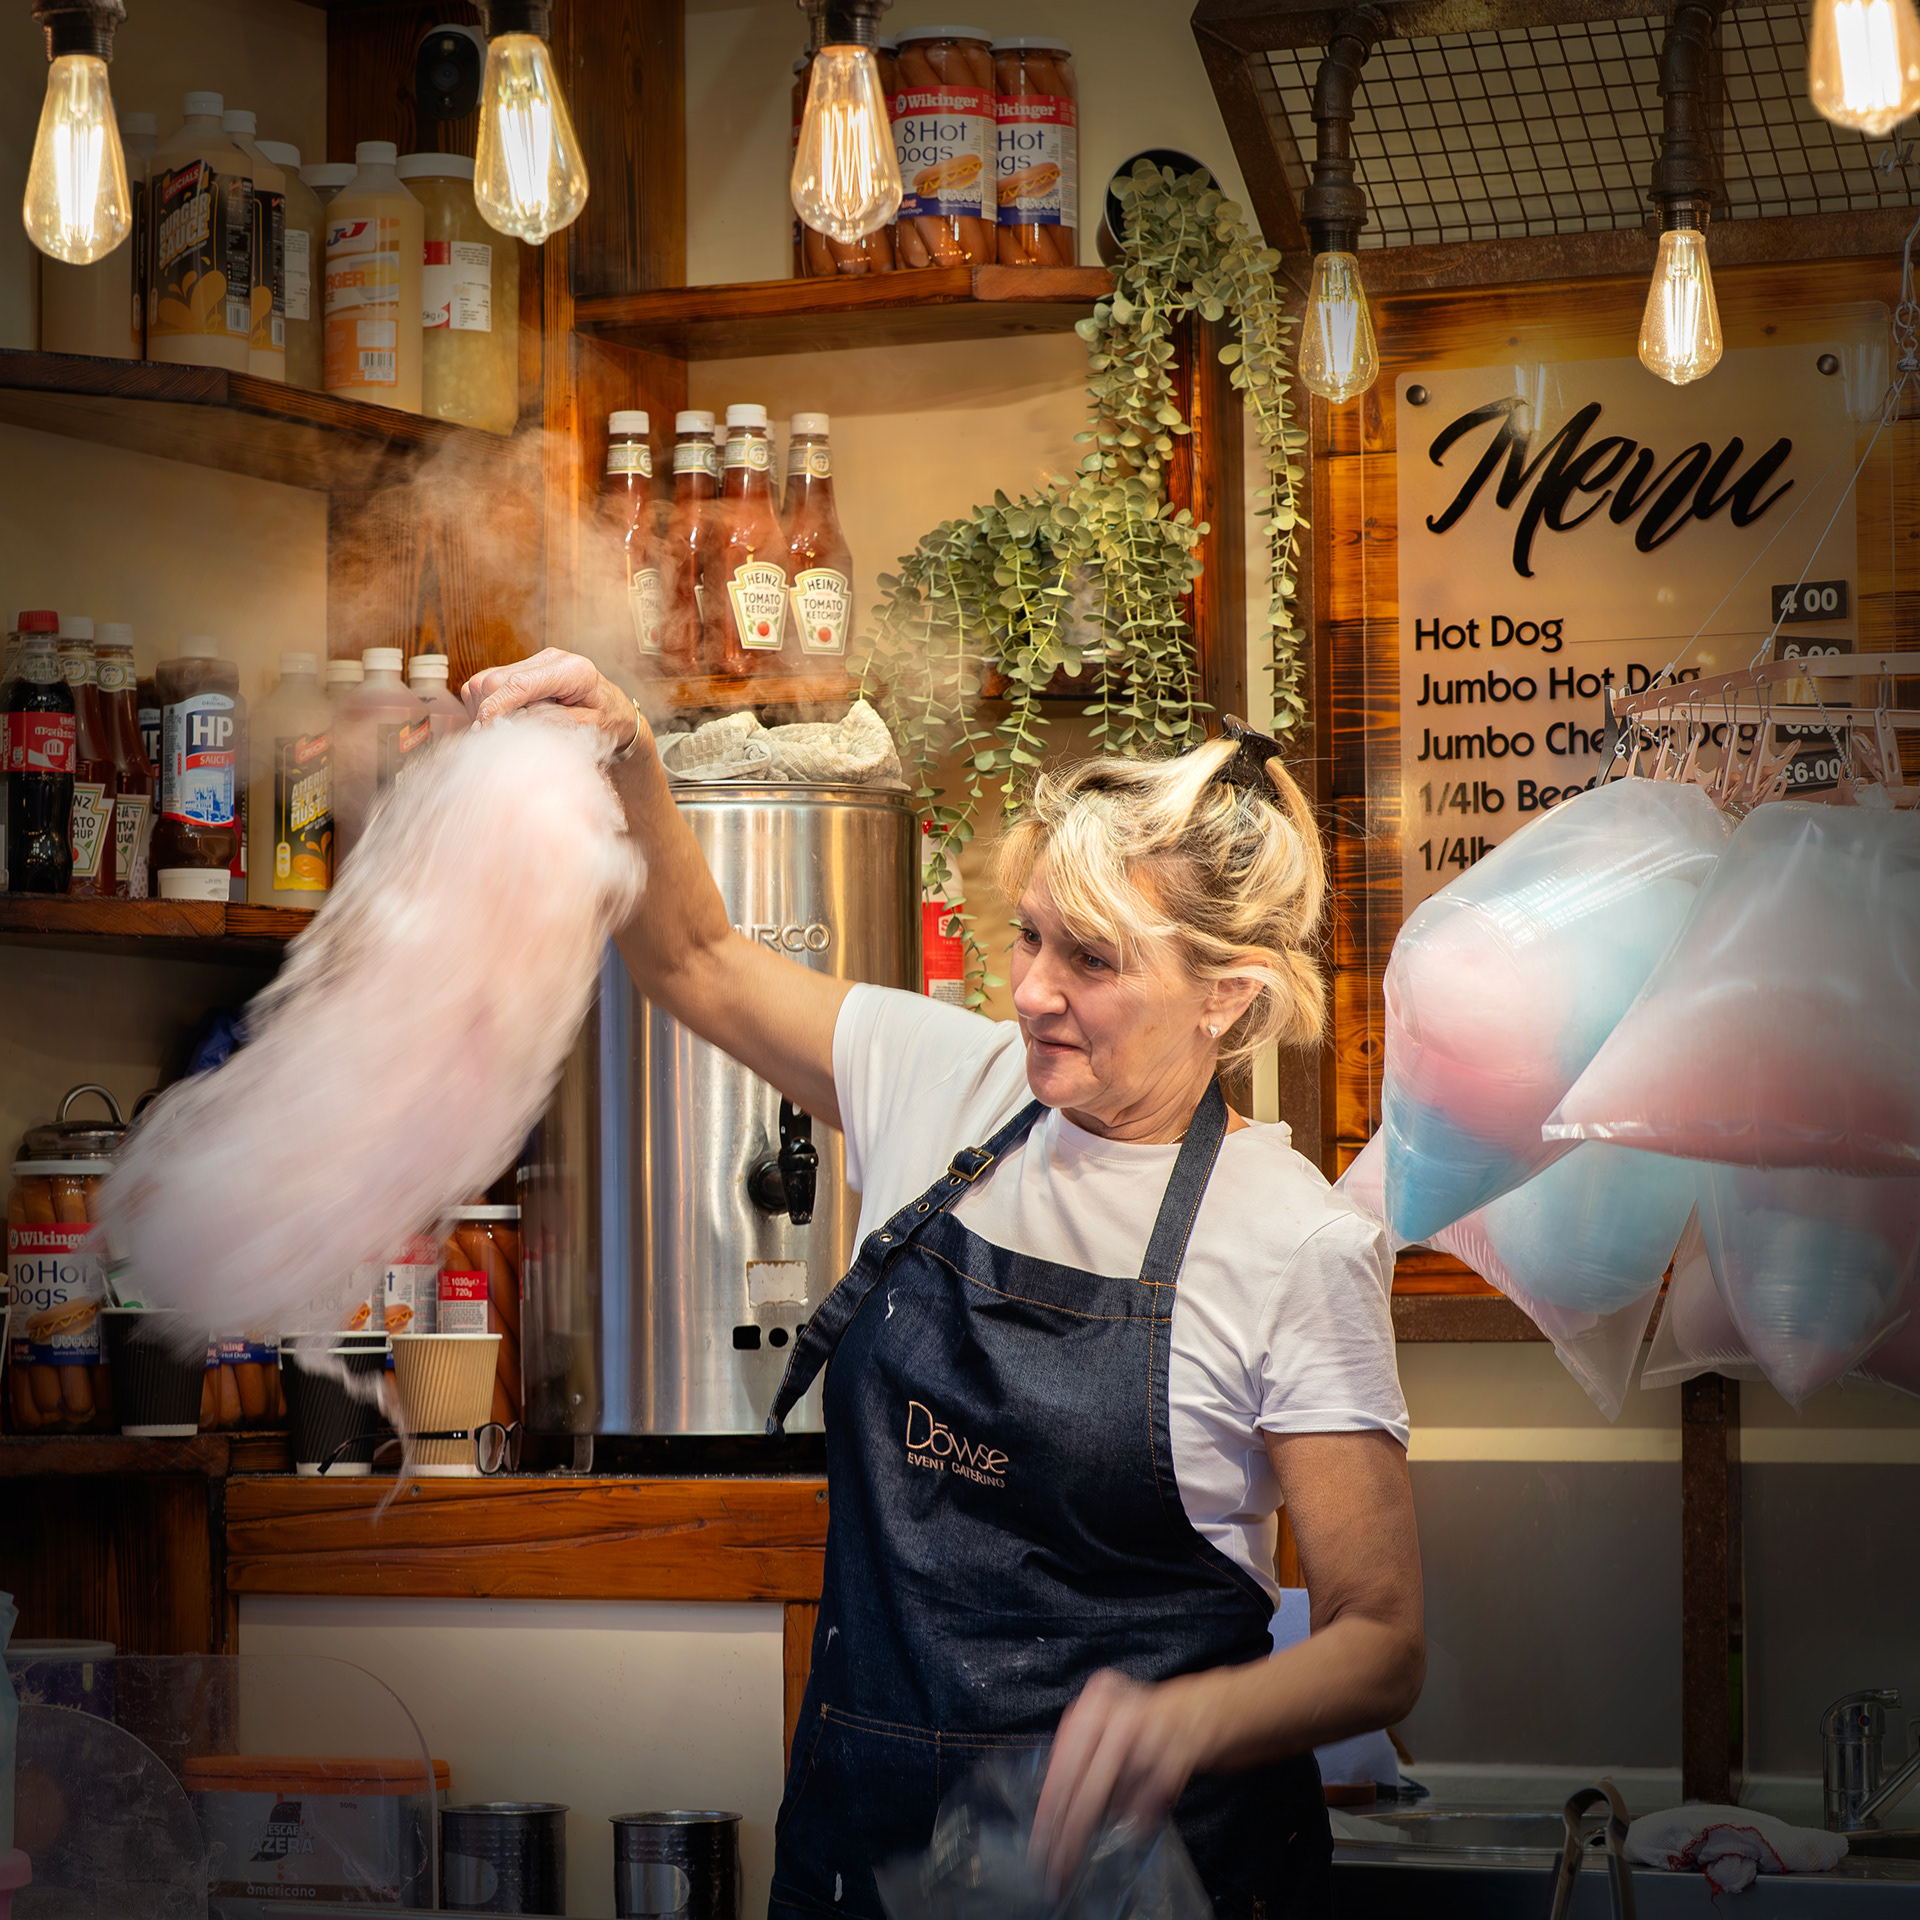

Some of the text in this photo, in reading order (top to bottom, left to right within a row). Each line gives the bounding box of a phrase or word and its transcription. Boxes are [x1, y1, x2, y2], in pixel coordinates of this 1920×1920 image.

[906, 93, 978, 110] Wikinger
[904, 120, 967, 144] 8 Hot
[998, 129, 1045, 152] Hot
[164, 168, 199, 200] CRUCIALS
[159, 194, 210, 243] BURGER
[158, 213, 209, 269] SAUCE
[326, 271, 366, 291] RGER
[1426, 396, 1794, 578] Menu
[746, 572, 778, 587] HEINZ
[807, 578, 840, 593] HEINZ
[743, 592, 781, 606] TOMATO
[803, 599, 843, 612] TOMATO
[746, 605, 779, 615] KETCHUP
[806, 610, 842, 621] KETCHUP
[1415, 615, 1564, 653] Hot Dog
[1783, 644, 1841, 660] 600
[1417, 670, 1537, 706] Jumbo
[1549, 666, 1615, 700] Hot
[192, 715, 234, 747] HP
[1417, 725, 1535, 761] Jumbo
[1546, 720, 1676, 755] Chese
[200, 755, 225, 765] SAUCE
[1419, 781, 1505, 816] 1/4lb
[20, 1230, 92, 1249] Wikinge
[13, 1263, 35, 1284] 10
[907, 1452, 947, 1471] EVENT
[249, 1836, 315, 1855] AZERA
[246, 1884, 317, 1898] americano
